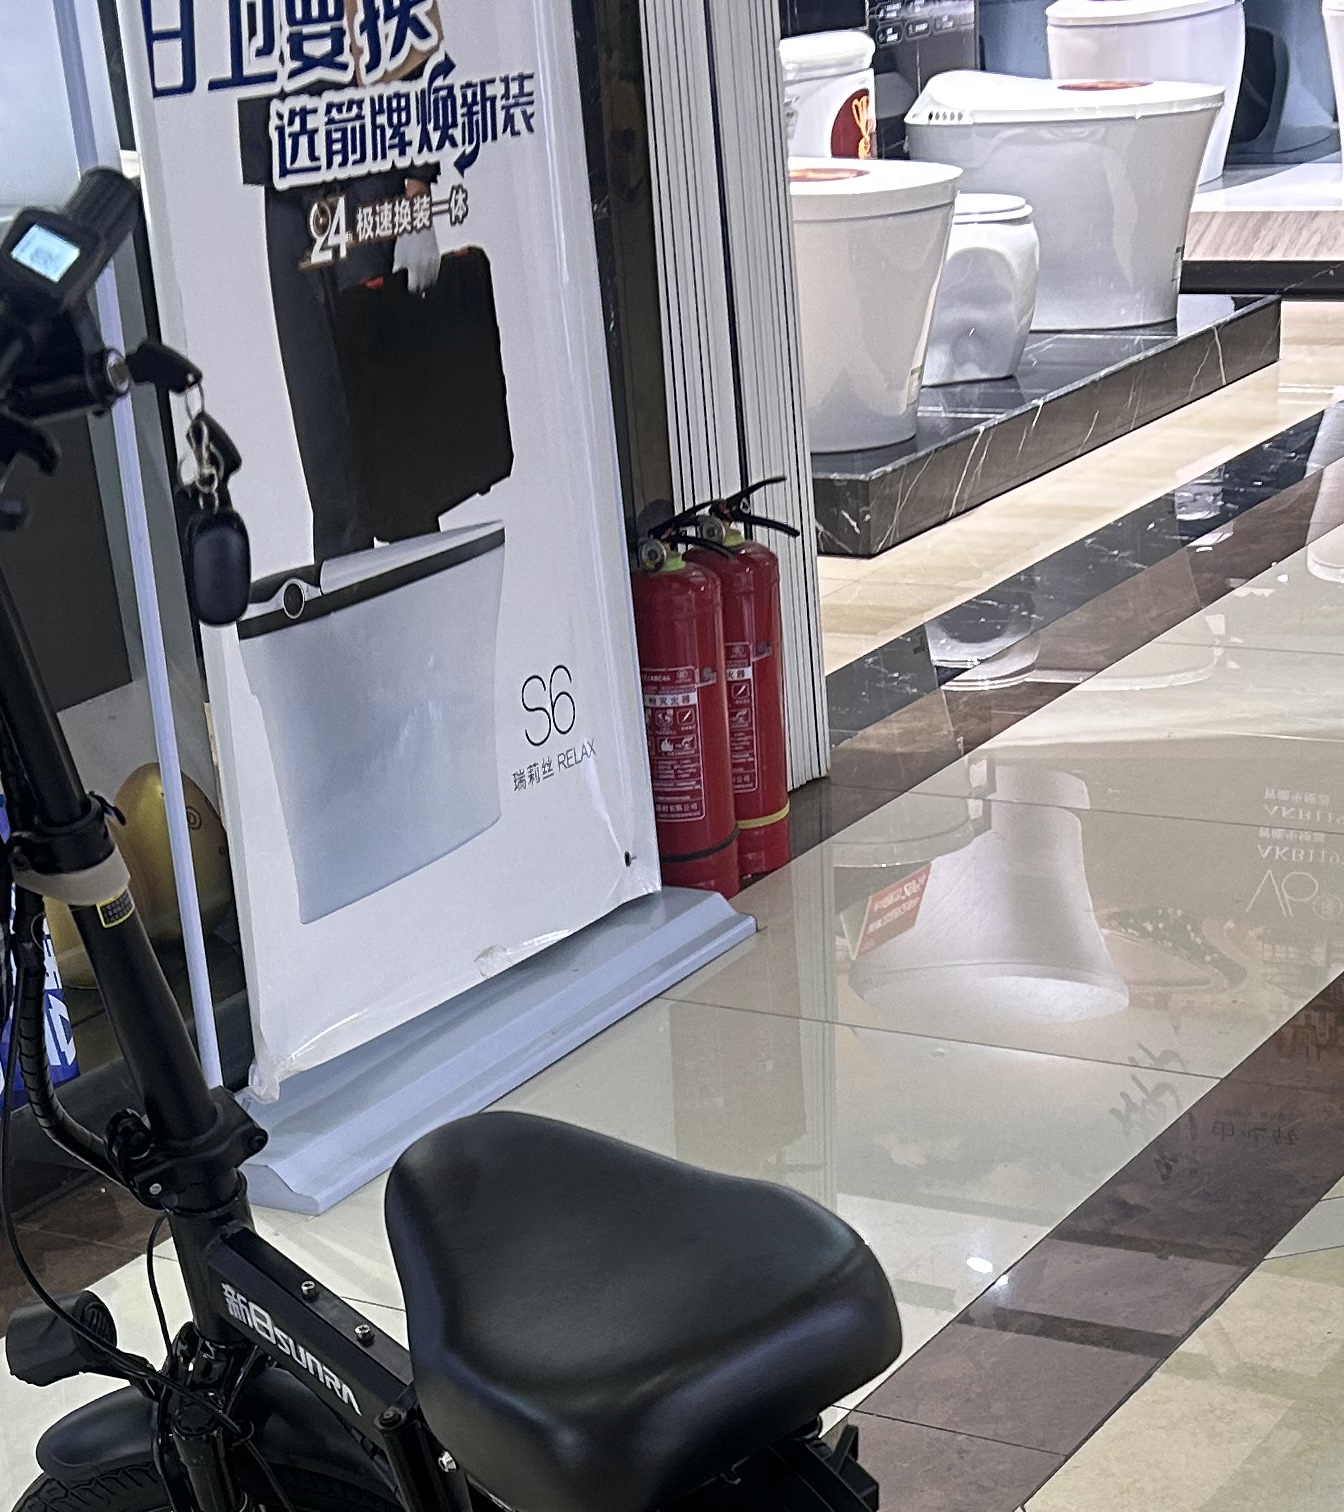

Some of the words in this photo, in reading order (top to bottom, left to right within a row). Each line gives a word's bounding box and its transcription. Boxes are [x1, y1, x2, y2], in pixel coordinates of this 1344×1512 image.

[274, 55, 536, 179] 选箭牌焕新装
[522, 665, 575, 746] S6
[557, 739, 596, 772] RELAX
[273, 1325, 363, 1418] SUNRA
